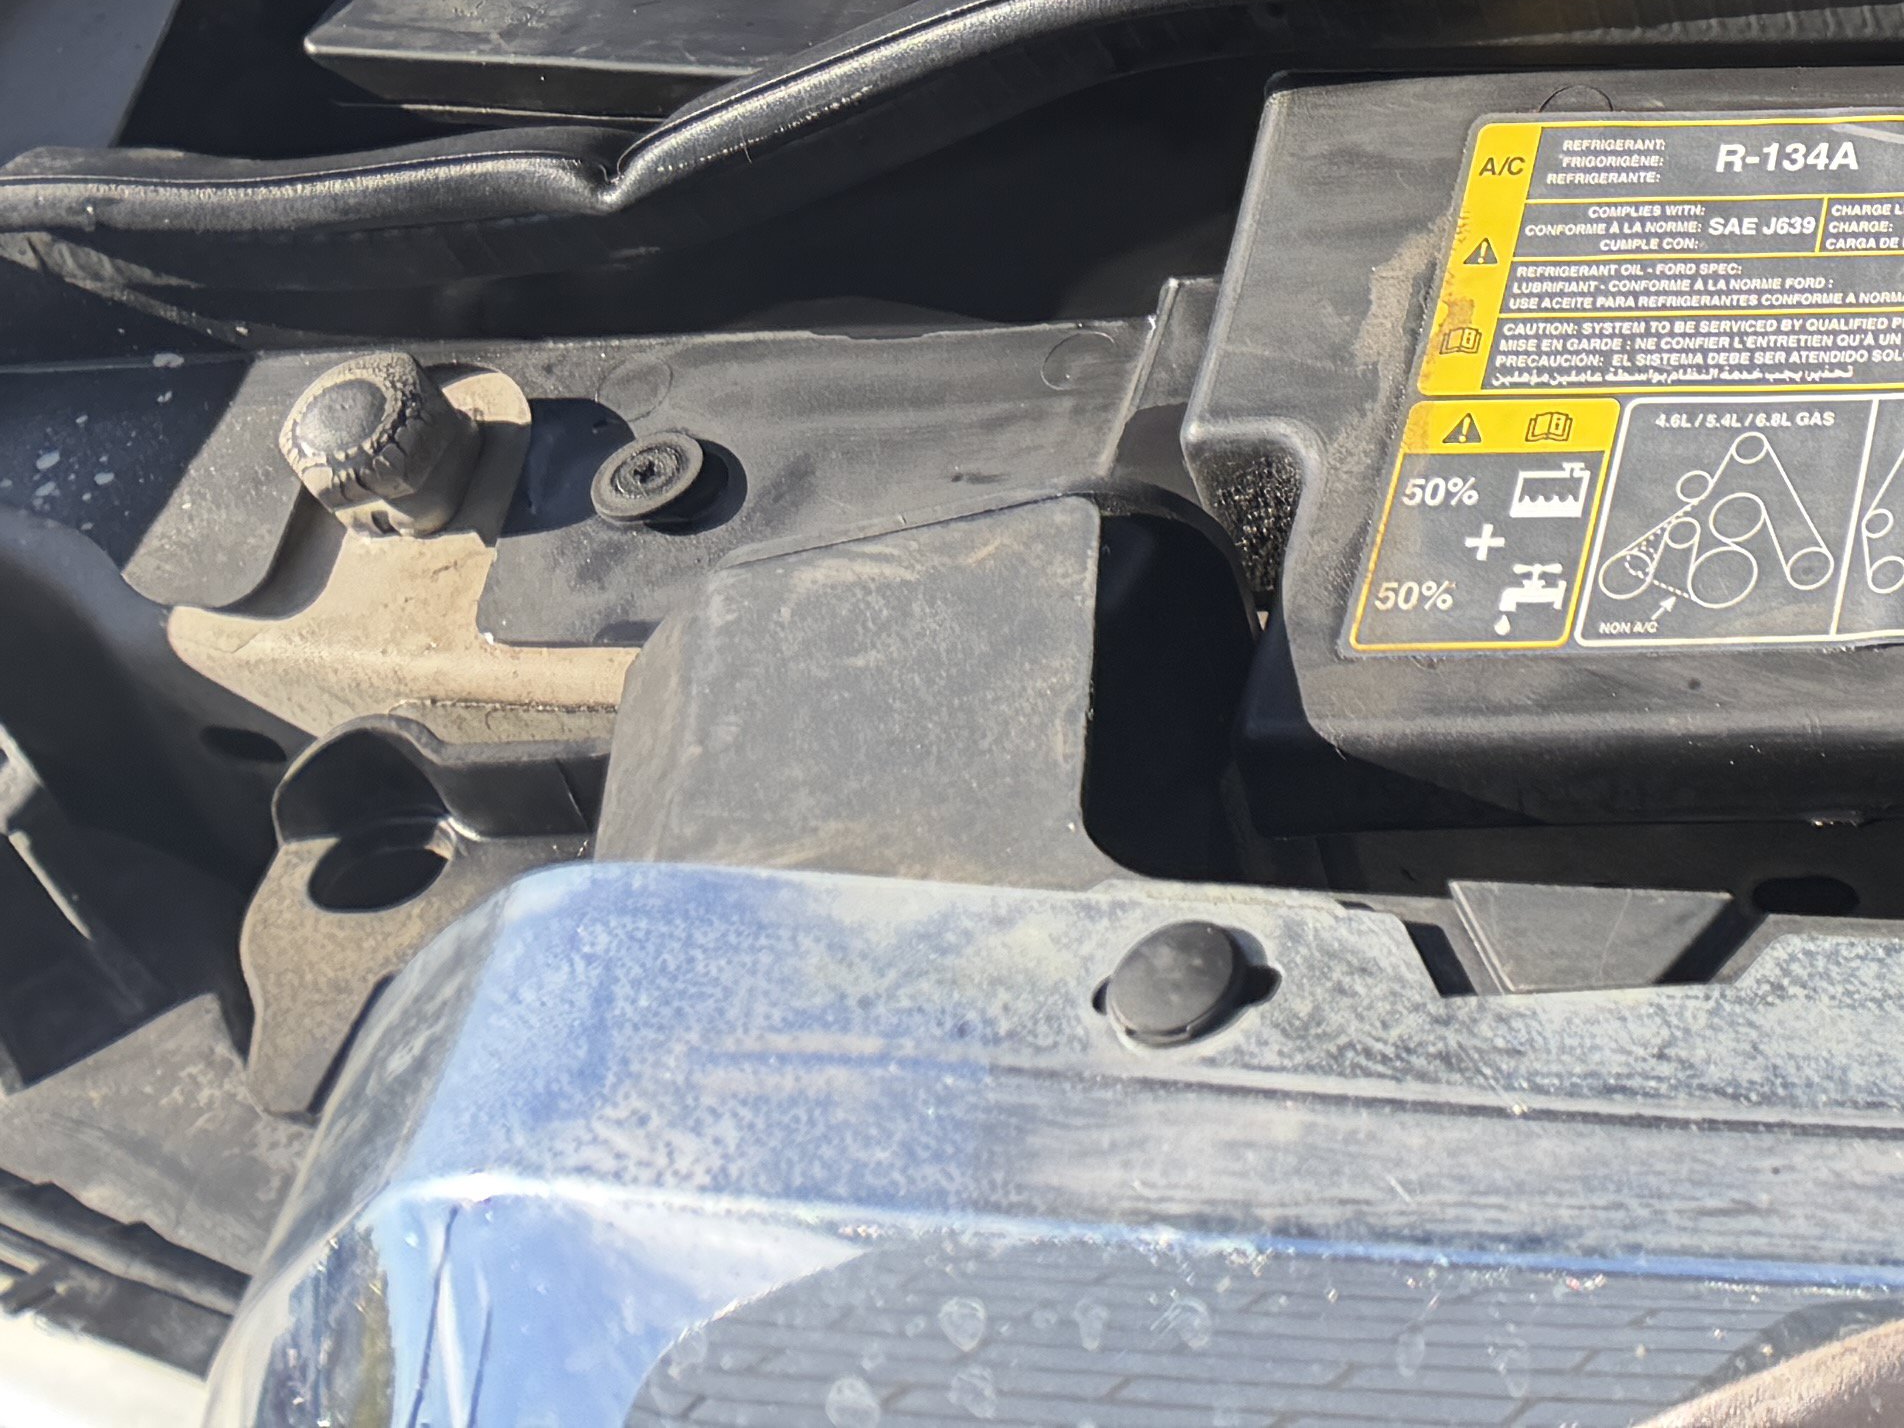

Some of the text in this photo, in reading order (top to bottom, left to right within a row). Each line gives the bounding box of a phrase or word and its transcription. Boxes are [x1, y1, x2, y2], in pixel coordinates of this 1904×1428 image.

[1562, 138, 1665, 151] REFRIGERANT:
[1716, 141, 1859, 172] R-134A
[1479, 157, 1525, 176] A/C
[1546, 171, 1660, 184] REFRIGERANTE:
[1588, 204, 1705, 218] COMPLIES WITH:
[1831, 204, 1892, 216] CHARGE
[1525, 223, 1607, 236] CONFORME
[1623, 221, 1642, 234] LA
[1645, 221, 1702, 233] NORME:
[1708, 216, 1816, 235] SAE J639
[1828, 221, 1893, 233] CHARGE:
[1599, 237, 1698, 251] CUMPLE CON:
[1825, 237, 1876, 249] CARGA
[1879, 237, 1899, 248] DE
[1517, 263, 1742, 277] REFRIGERANT OIL FORD SPEC:
[1512, 280, 1599, 294] LUBRIFIANT
[1608, 279, 1691, 292] CONFORME
[1707, 279, 1727, 291] LA
[1729, 278, 1782, 290] NORME
[1785, 277, 1825, 289] FORD
[1503, 322, 1578, 336] CAUTION:
[1581, 321, 1645, 335] SYSTEM
[1650, 321, 1670, 334] TO
[1674, 321, 1696, 333] BE
[1699, 319, 1778, 333] SERVICED
[1780, 319, 1803, 331] BY
[1806, 317, 1888, 331] QUALIFIED
[1499, 339, 1538, 351] MISE
[1541, 338, 1563, 351] EN
[1566, 338, 1622, 351] GARDE
[1635, 337, 1658, 350] NE
[1660, 336, 1730, 349] CONFIER
[1733, 331, 1834, 349] L'ENTRETIEN
[1879, 332, 1901, 346] UN
[1495, 350, 1605, 367] PRECAUCIÓN:
[1612, 354, 1631, 367] EL
[1635, 352, 1703, 366] SISTEMA
[1707, 352, 1751, 365] DEBE
[1754, 351, 1786, 364] SER
[1789, 349, 1868, 364] ATENDIDO
[1655, 411, 1835, 428] 4.6L 5.4L 6.8L GAS
[1401, 477, 1479, 506] 50%
[1374, 580, 1456, 611] 50%
